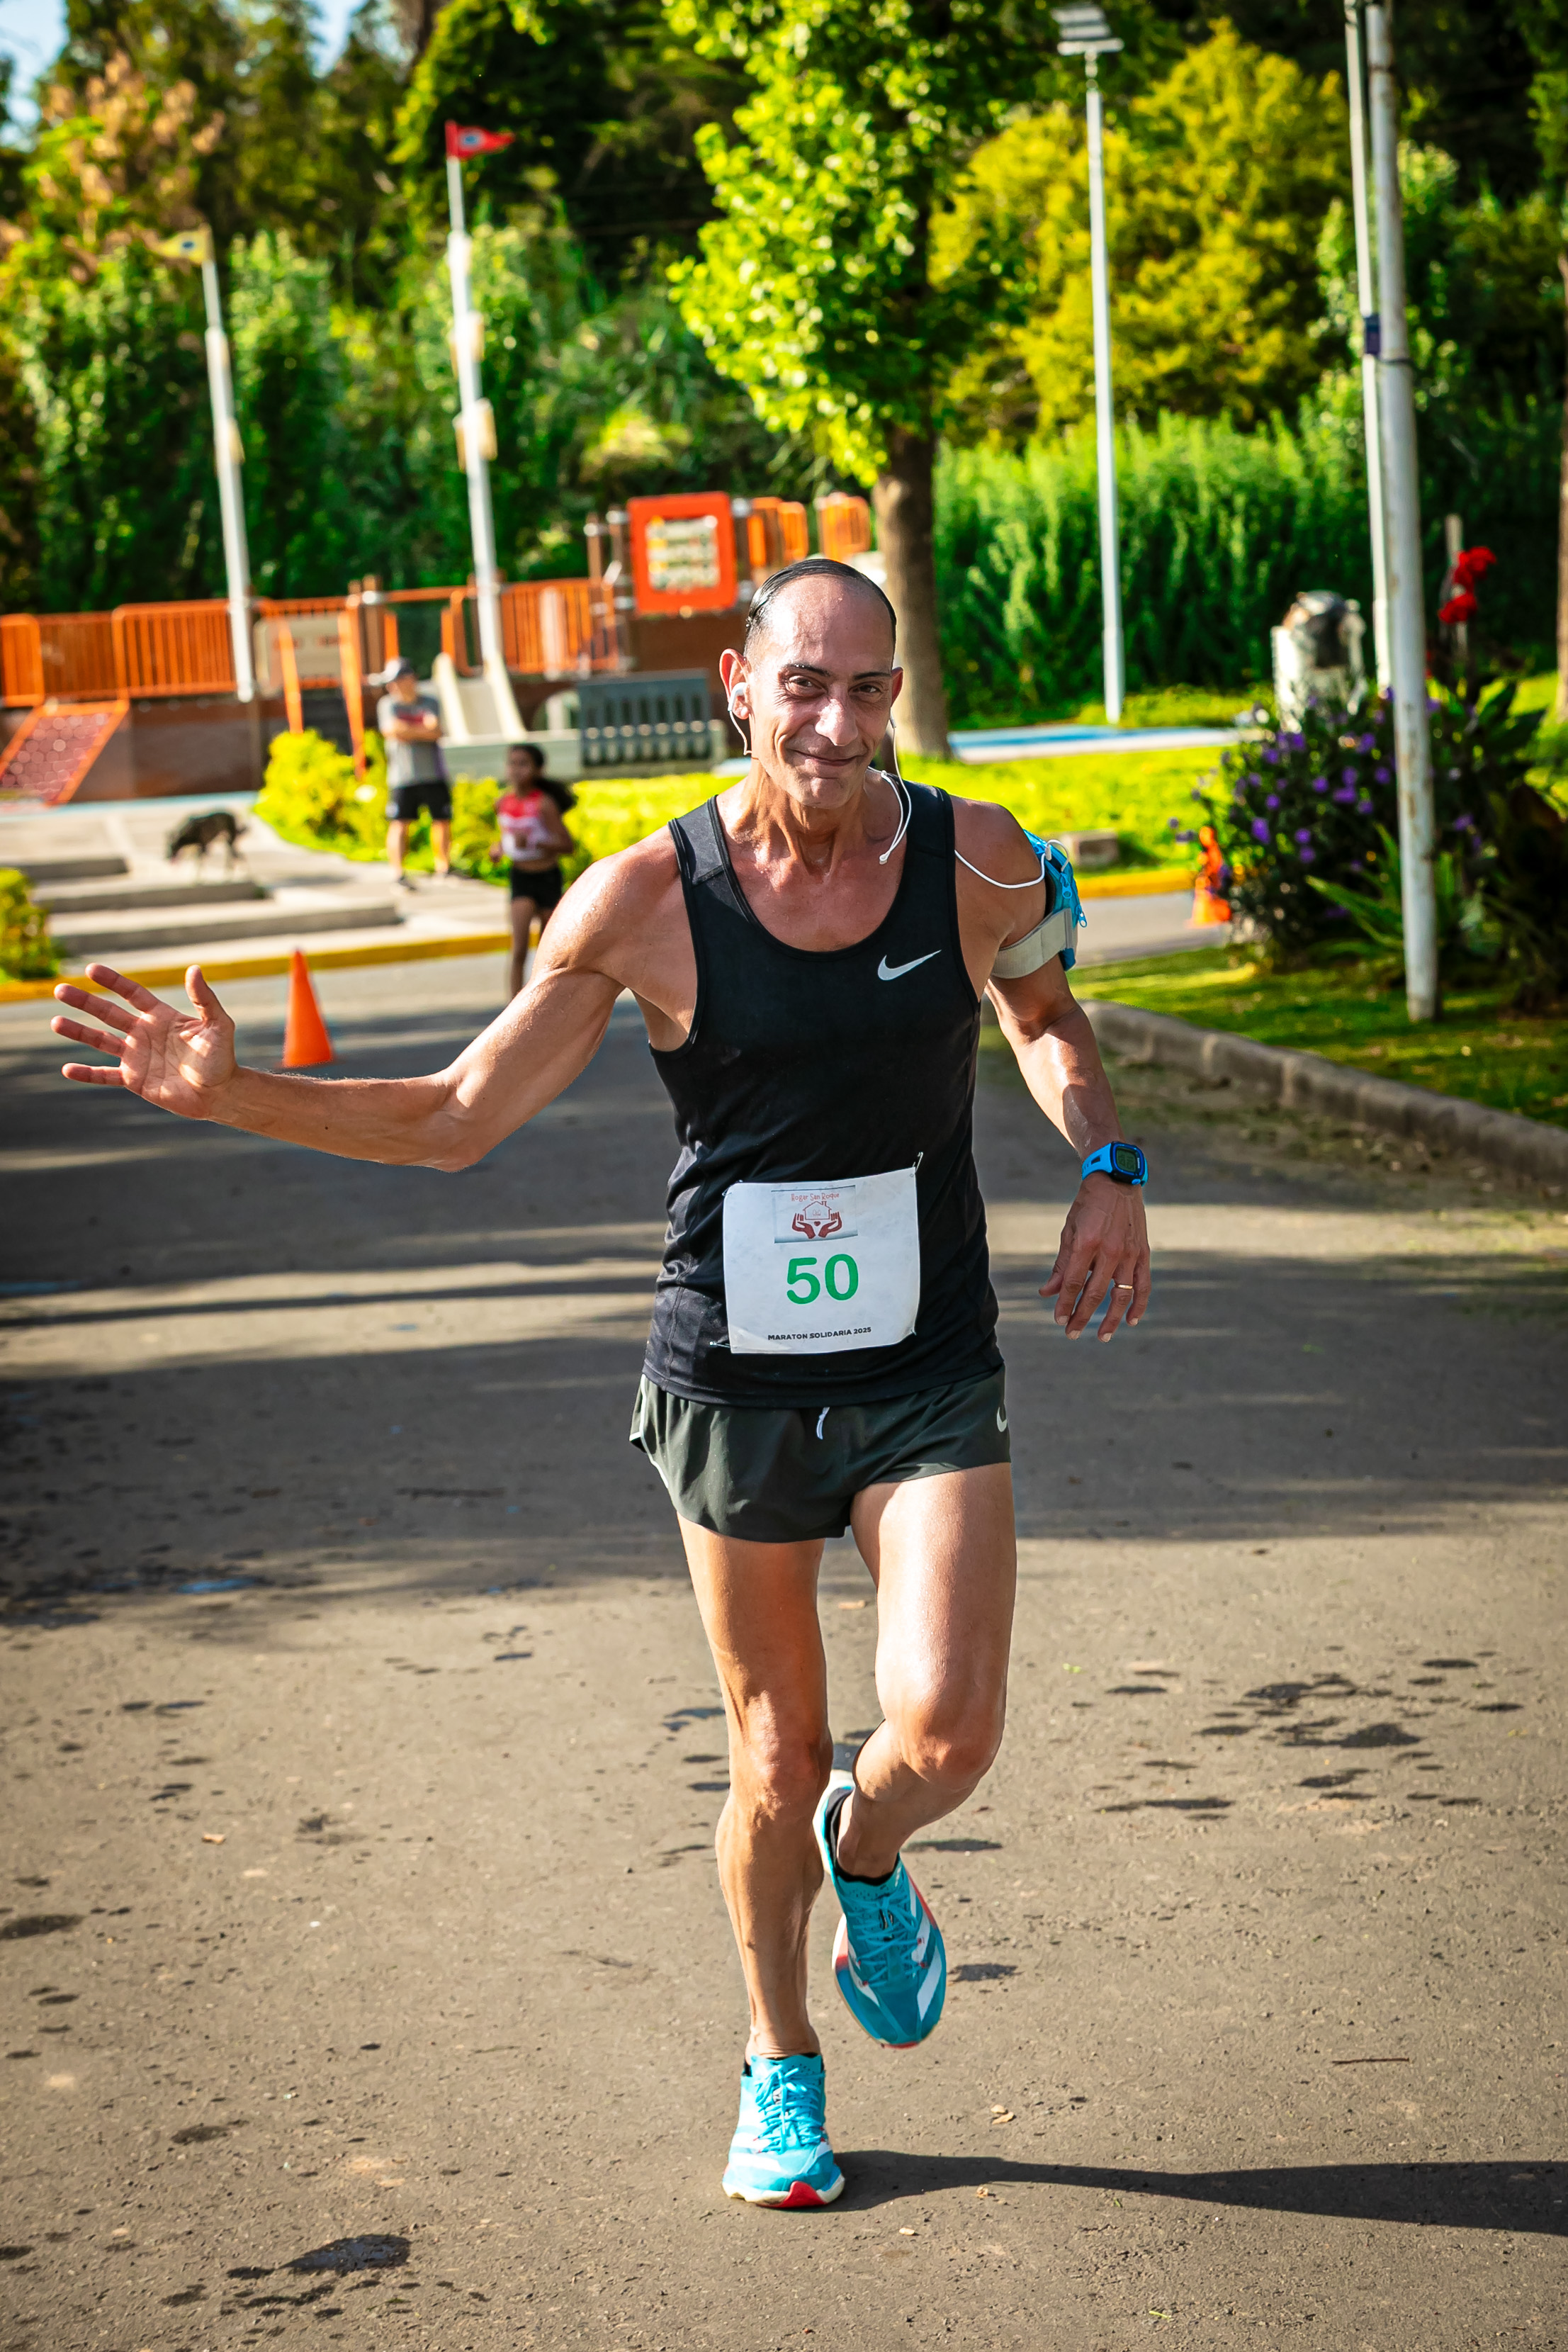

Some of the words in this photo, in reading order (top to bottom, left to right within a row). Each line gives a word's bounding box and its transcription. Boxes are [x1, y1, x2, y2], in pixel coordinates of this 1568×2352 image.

[791, 1193, 808, 1202] Hogar
[810, 1193, 820, 1201] San
[786, 1254, 859, 1305] 50
[809, 1329, 852, 1339] SOLIDARIA
